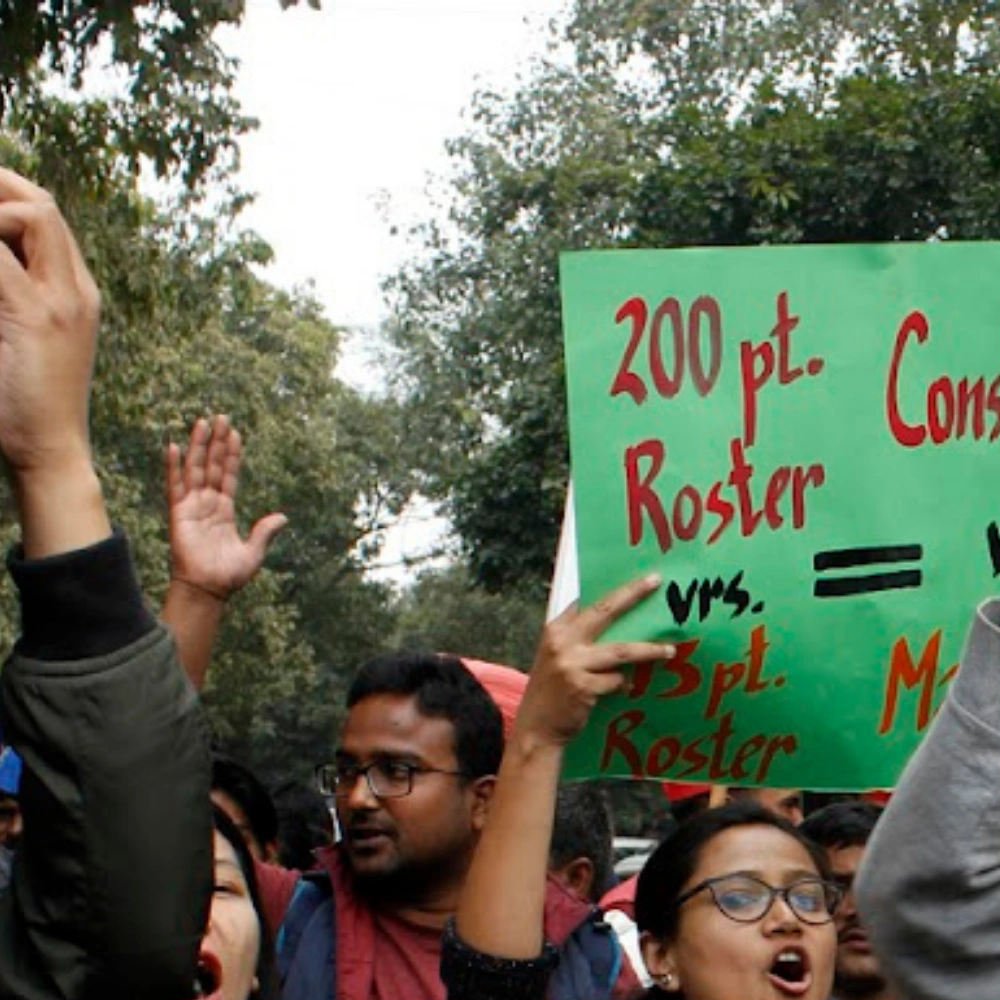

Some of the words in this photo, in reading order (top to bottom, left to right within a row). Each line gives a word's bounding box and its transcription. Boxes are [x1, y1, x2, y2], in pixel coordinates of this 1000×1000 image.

[610, 296, 722, 404] 200
[740, 291, 825, 447] pt.
[624, 437, 826, 553] Roster
[665, 571, 765, 626] vrs.
[705, 624, 787, 720] pt.
[601, 708, 797, 784] Roster
